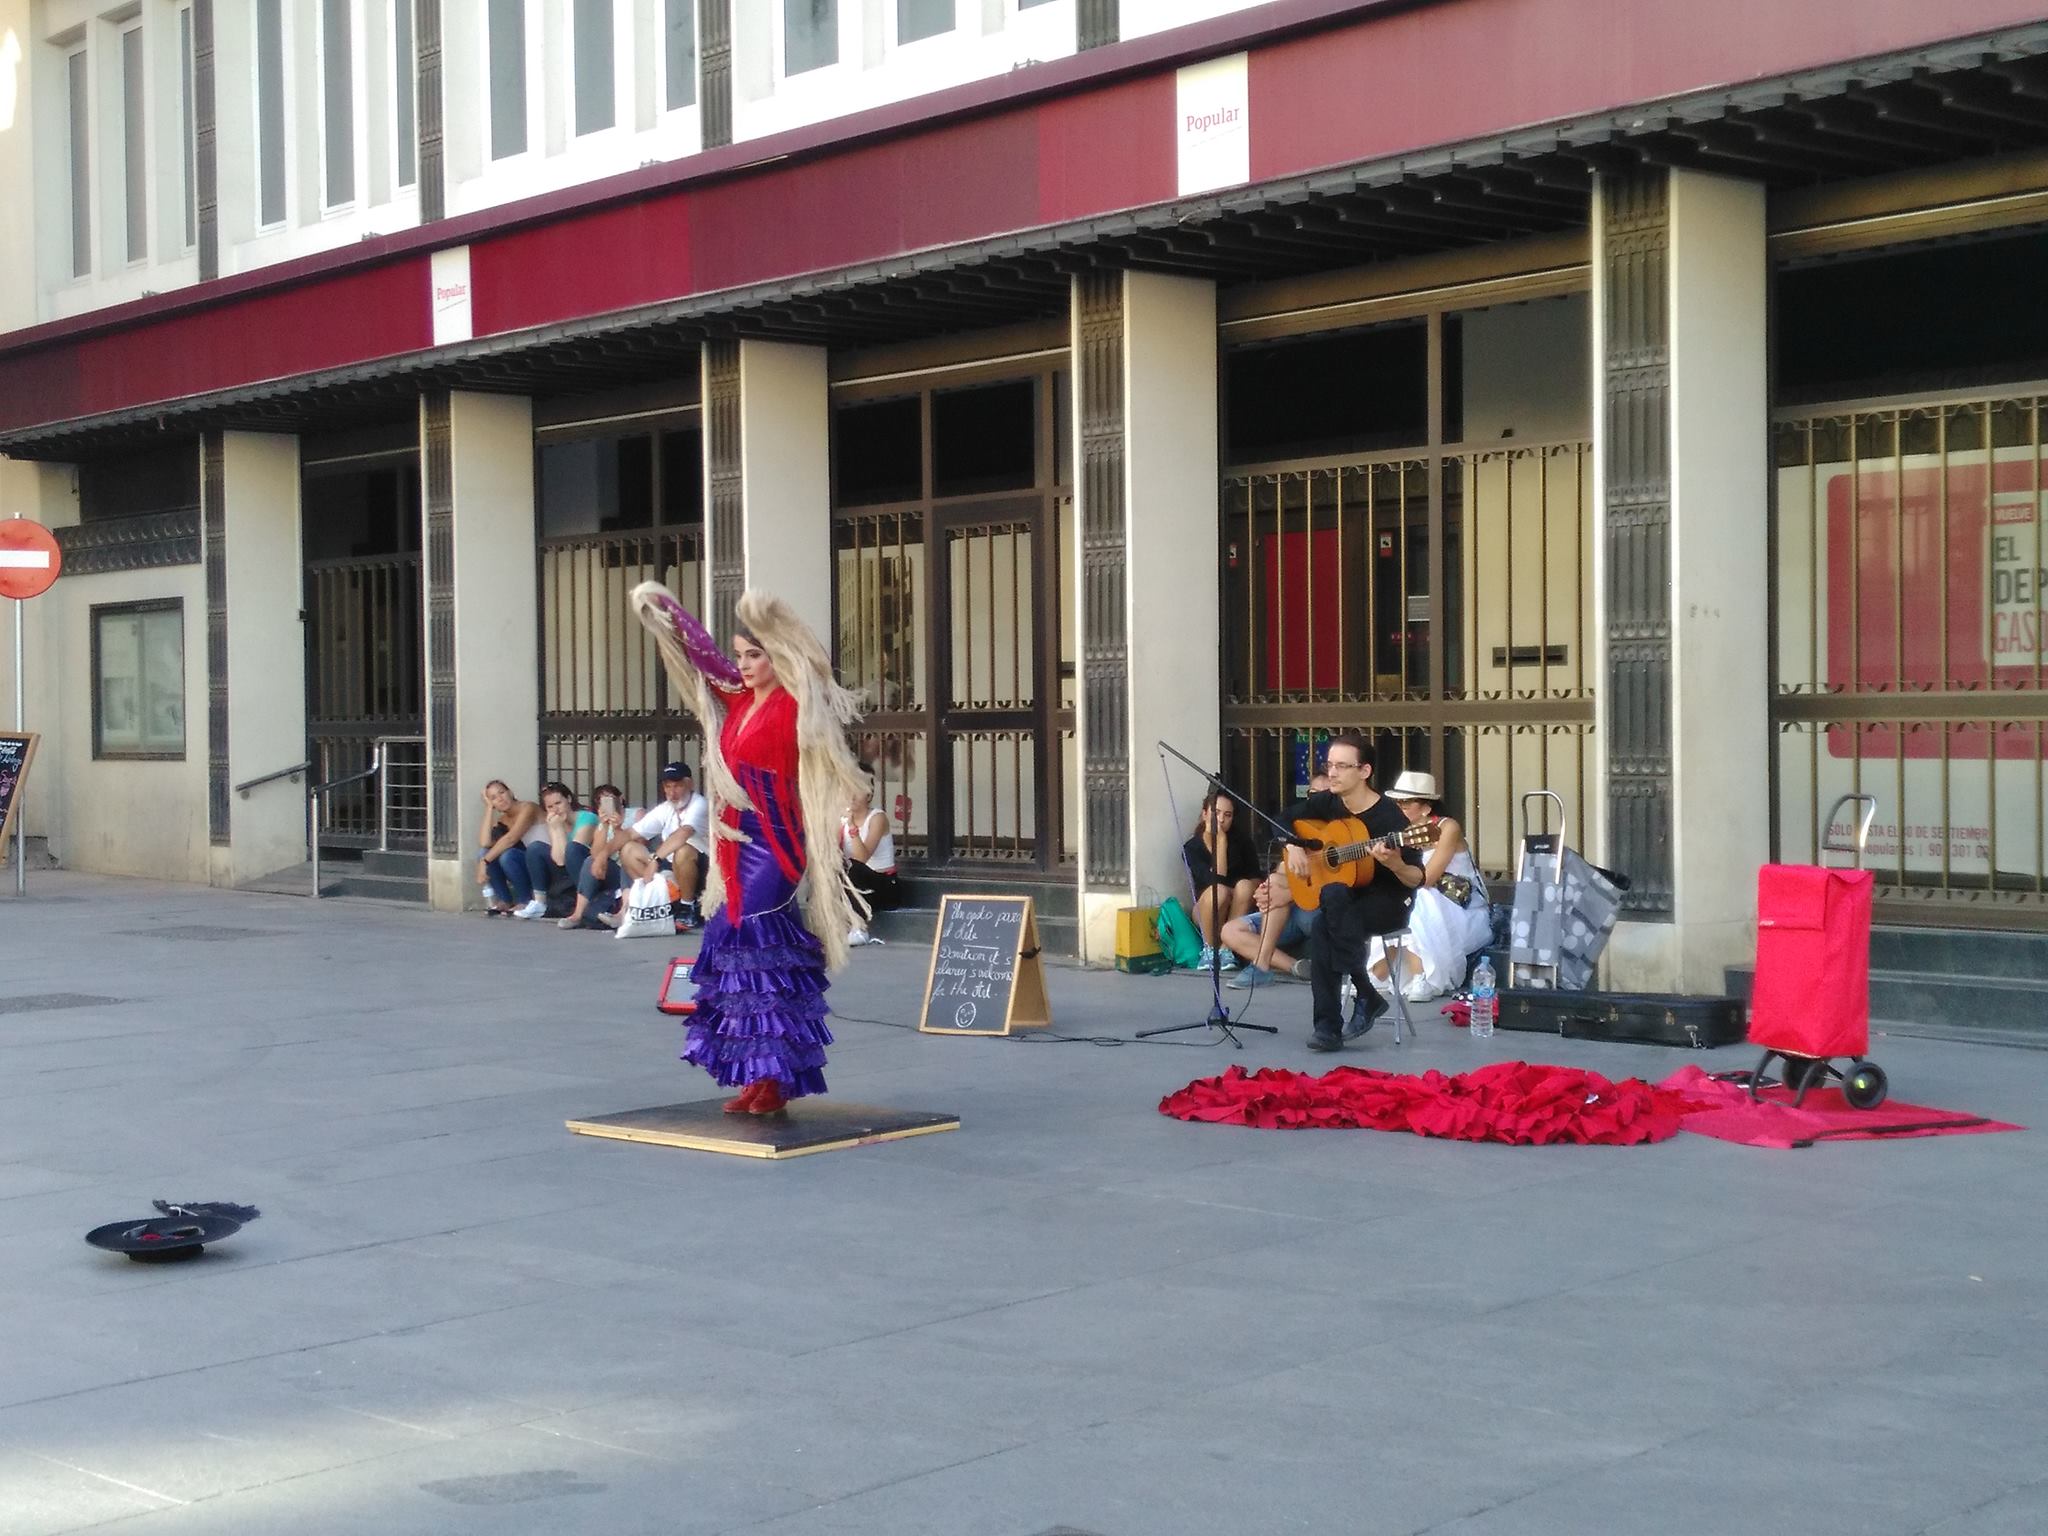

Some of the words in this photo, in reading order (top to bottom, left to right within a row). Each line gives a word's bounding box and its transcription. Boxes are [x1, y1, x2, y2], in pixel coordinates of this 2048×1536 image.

[1186, 107, 1240, 132] Popular
[437, 284, 466, 301] Popular
[1994, 535, 2021, 562] EL
[1931, 826, 1993, 842] SETIEMBR
